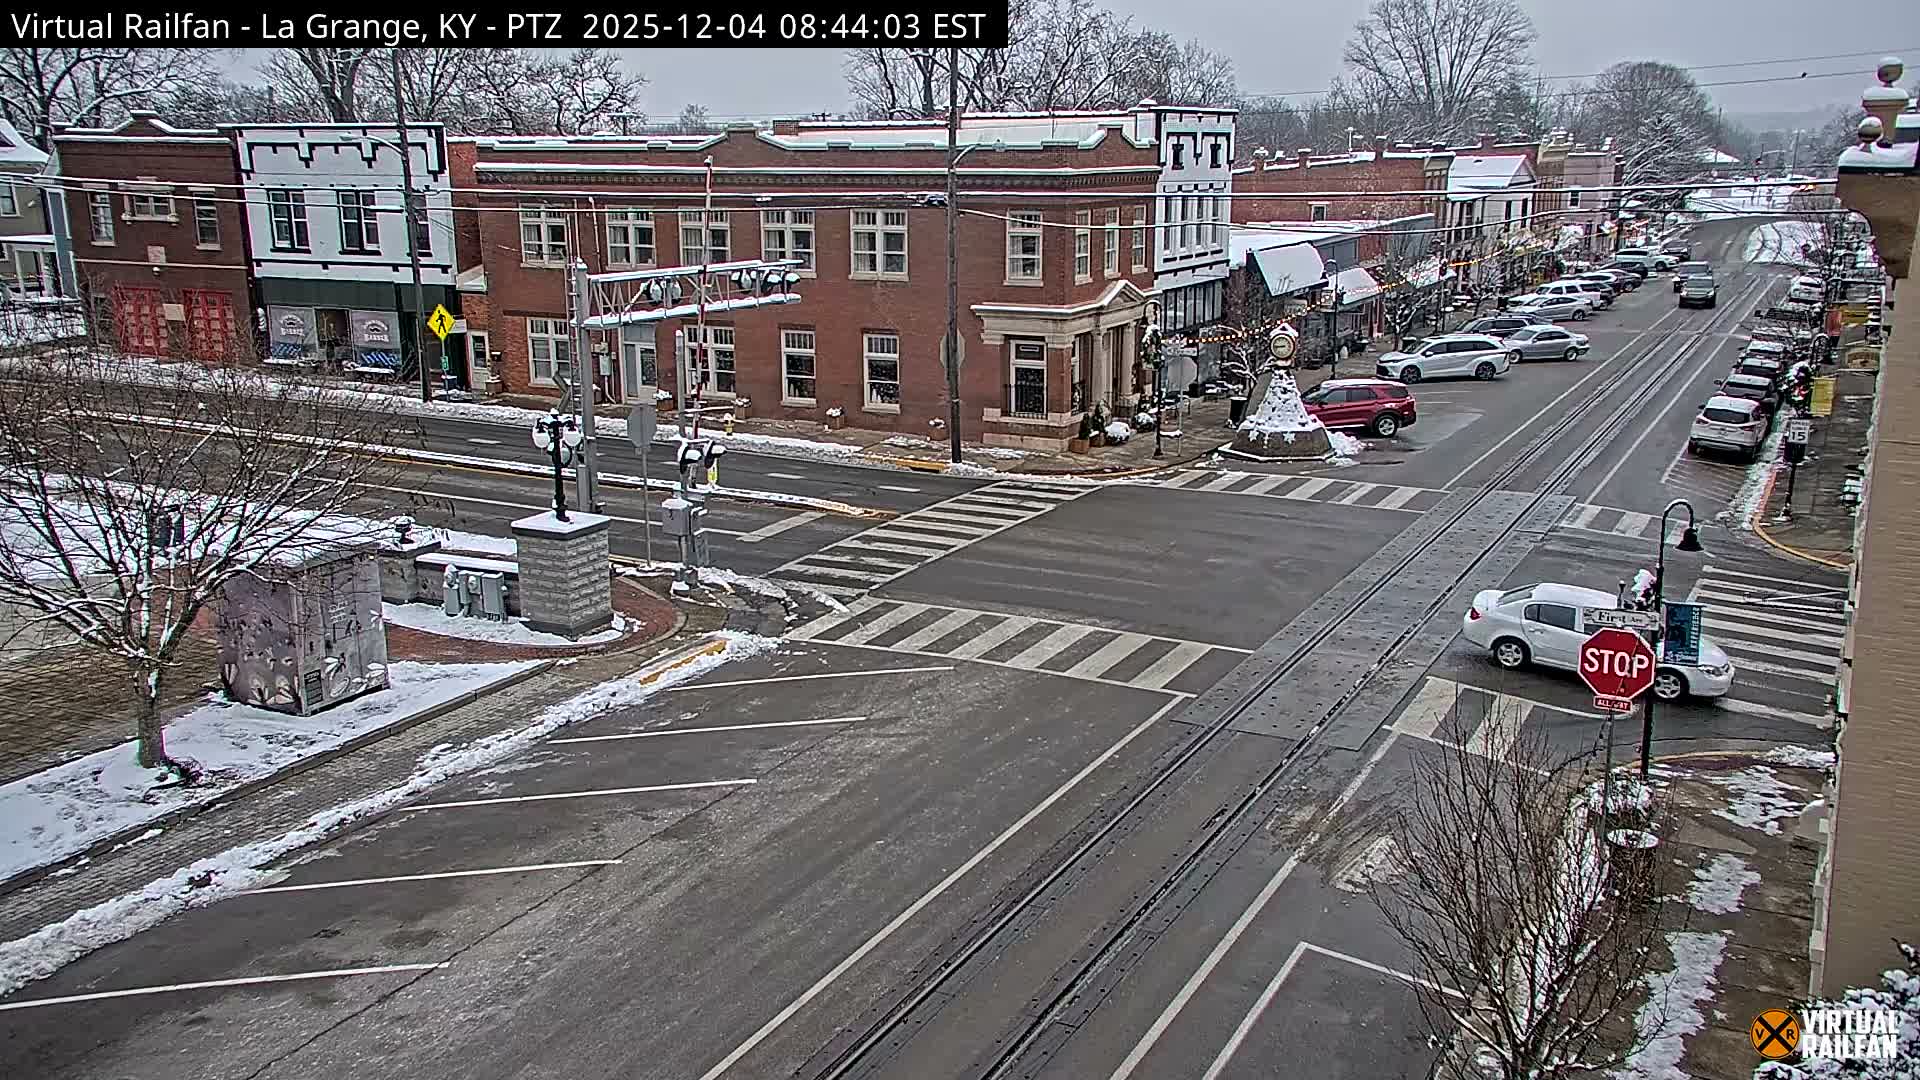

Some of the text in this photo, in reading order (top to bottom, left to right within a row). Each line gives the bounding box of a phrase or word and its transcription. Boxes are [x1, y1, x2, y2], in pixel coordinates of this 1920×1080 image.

[1792, 432, 1806, 441] 15
[1583, 648, 1649, 678] STOP
[1597, 699, 1609, 707] ALL
